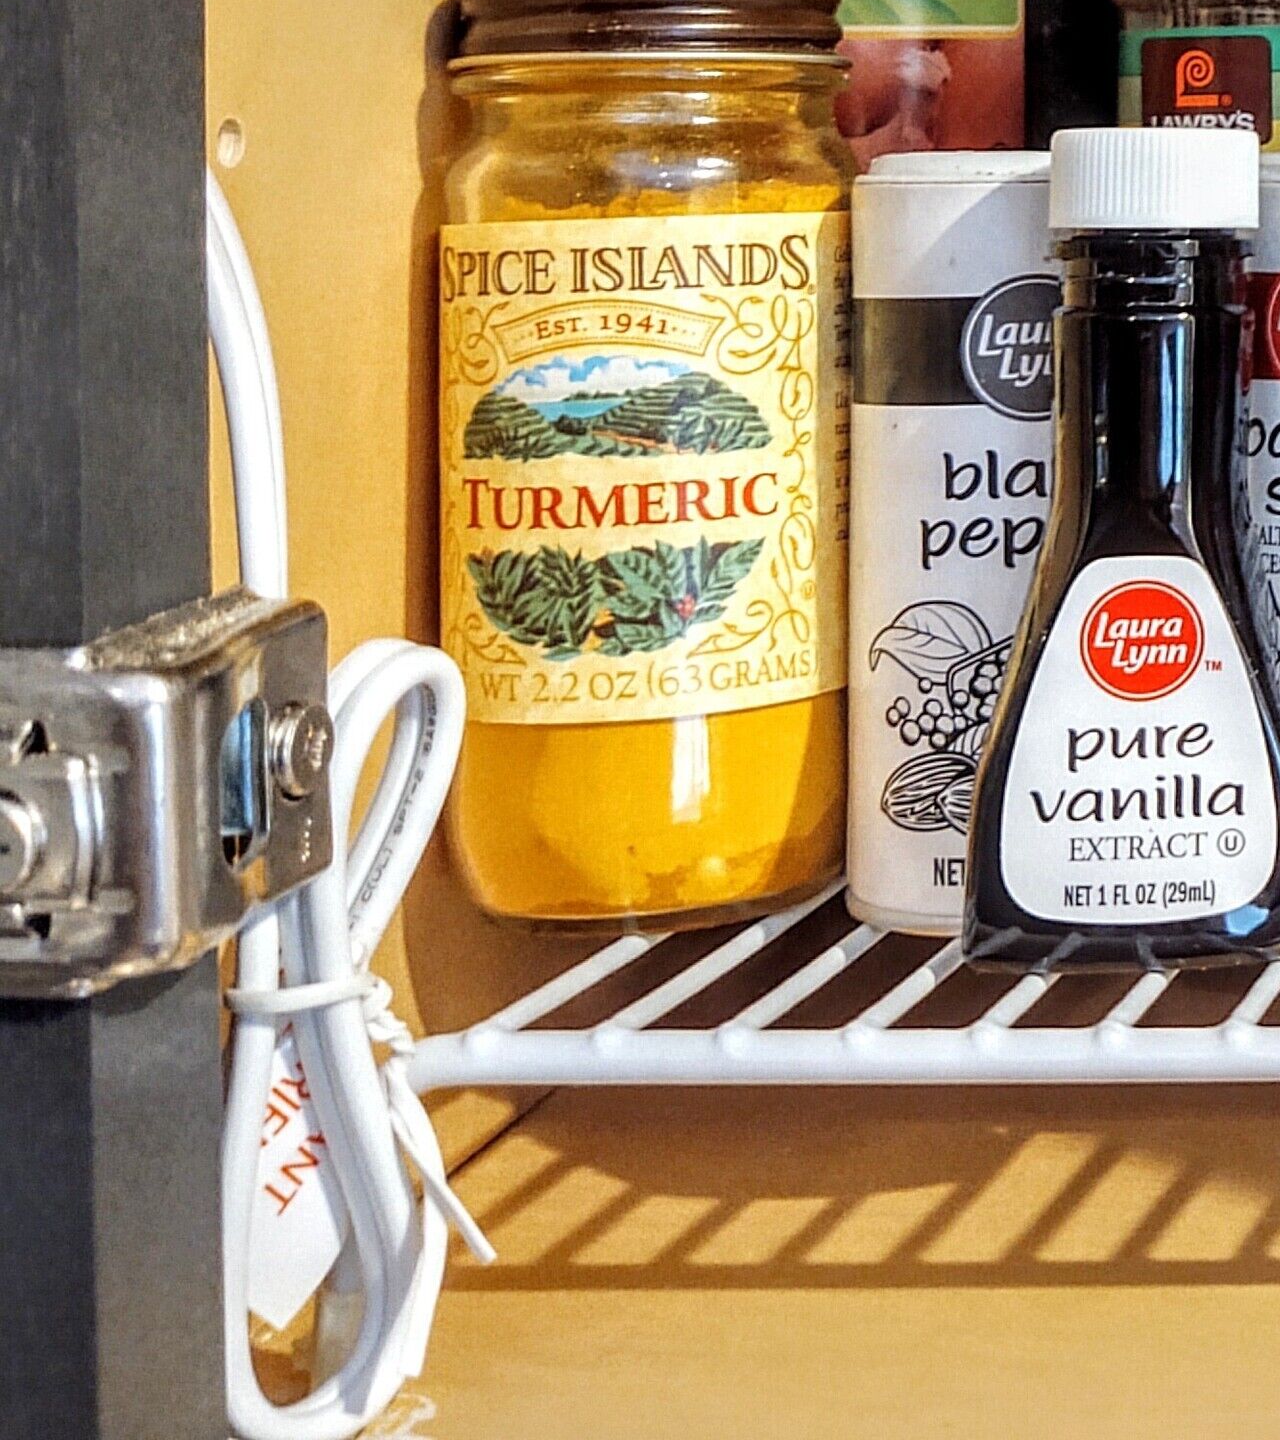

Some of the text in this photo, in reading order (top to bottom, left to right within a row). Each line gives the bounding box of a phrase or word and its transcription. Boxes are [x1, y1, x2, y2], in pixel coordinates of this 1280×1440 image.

[443, 235, 811, 302] SPICE ISLANDS
[536, 313, 668, 340] EST. 1941
[462, 472, 780, 531] TURMERIC
[1094, 612, 1184, 648] Laura
[1111, 642, 1188, 674] Lynn
[480, 674, 521, 703] WT
[532, 674, 580, 703] 2.2
[589, 670, 638, 700] OZ
[648, 661, 703, 699] (63
[1068, 721, 1214, 773] pure
[1029, 773, 1245, 823] vanilla
[1069, 831, 1208, 862] EXTRACT
[933, 857, 966, 887] NET
[1064, 879, 1215, 908] NET 1 FL OZ (29mL)
